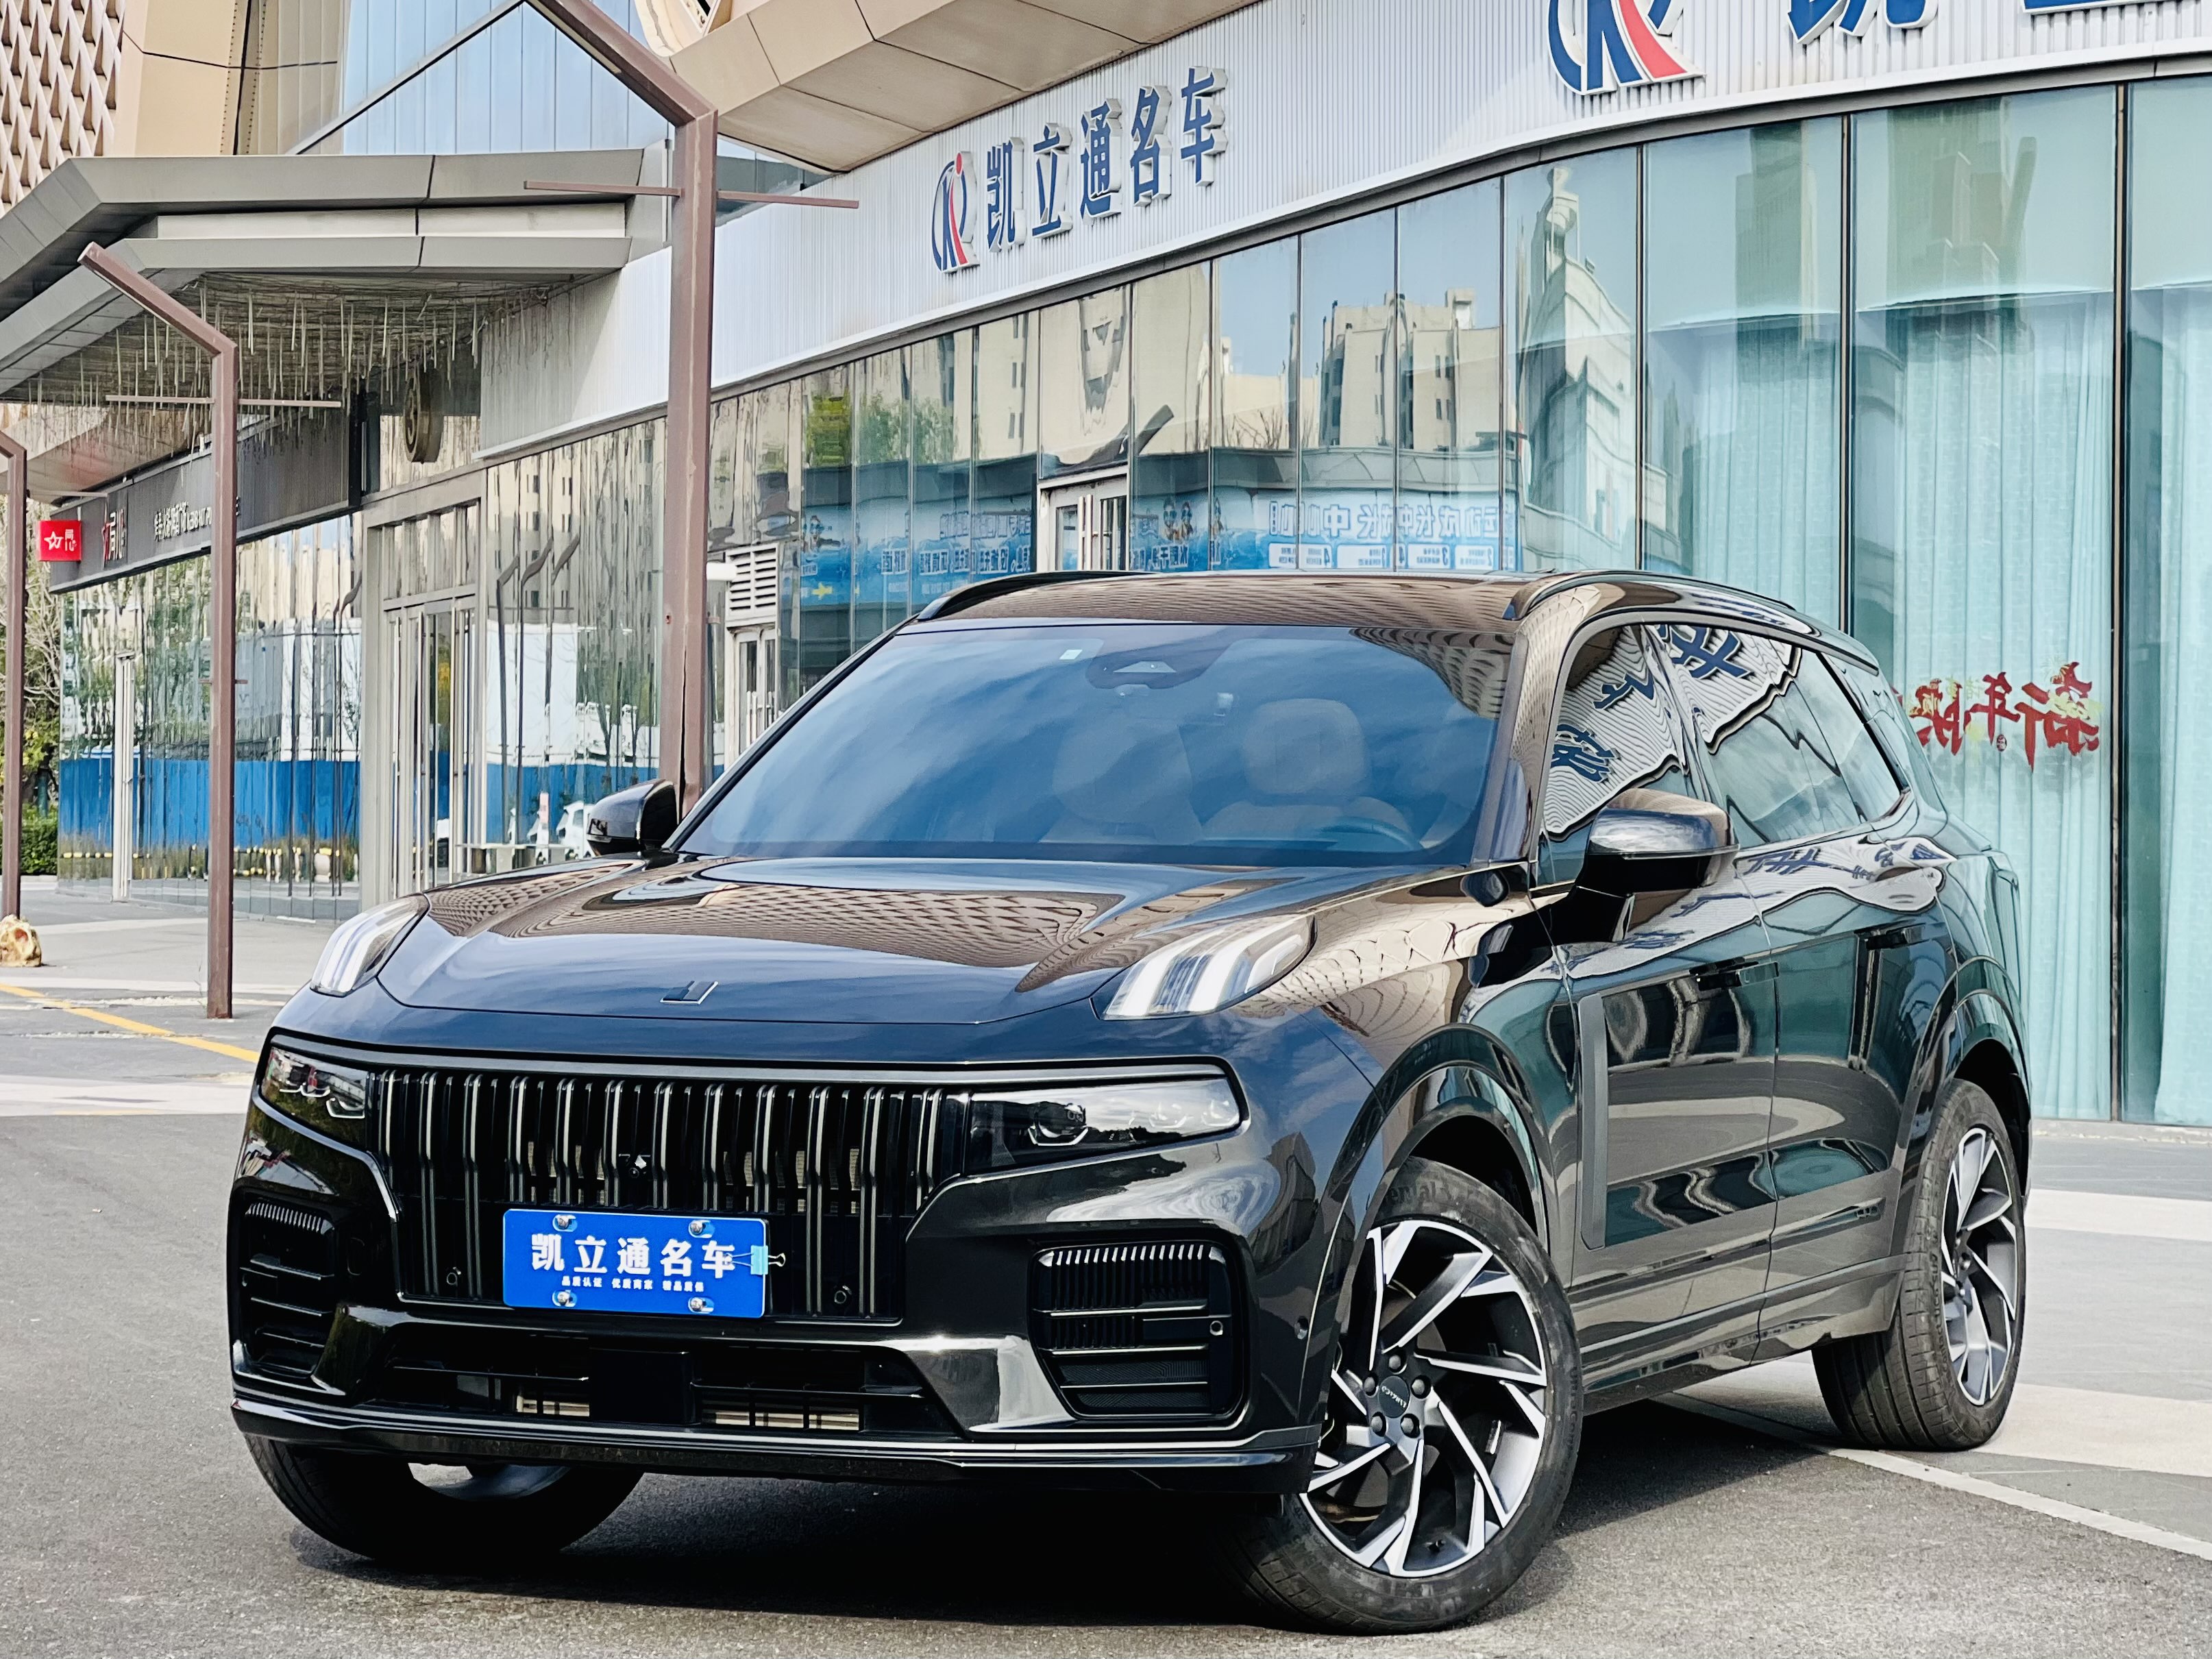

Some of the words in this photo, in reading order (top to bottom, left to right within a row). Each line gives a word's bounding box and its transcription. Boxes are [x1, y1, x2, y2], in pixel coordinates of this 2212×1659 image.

[987, 66, 1225, 252] 凯立通名车
[531, 1233, 736, 1279] 凯立通名车
